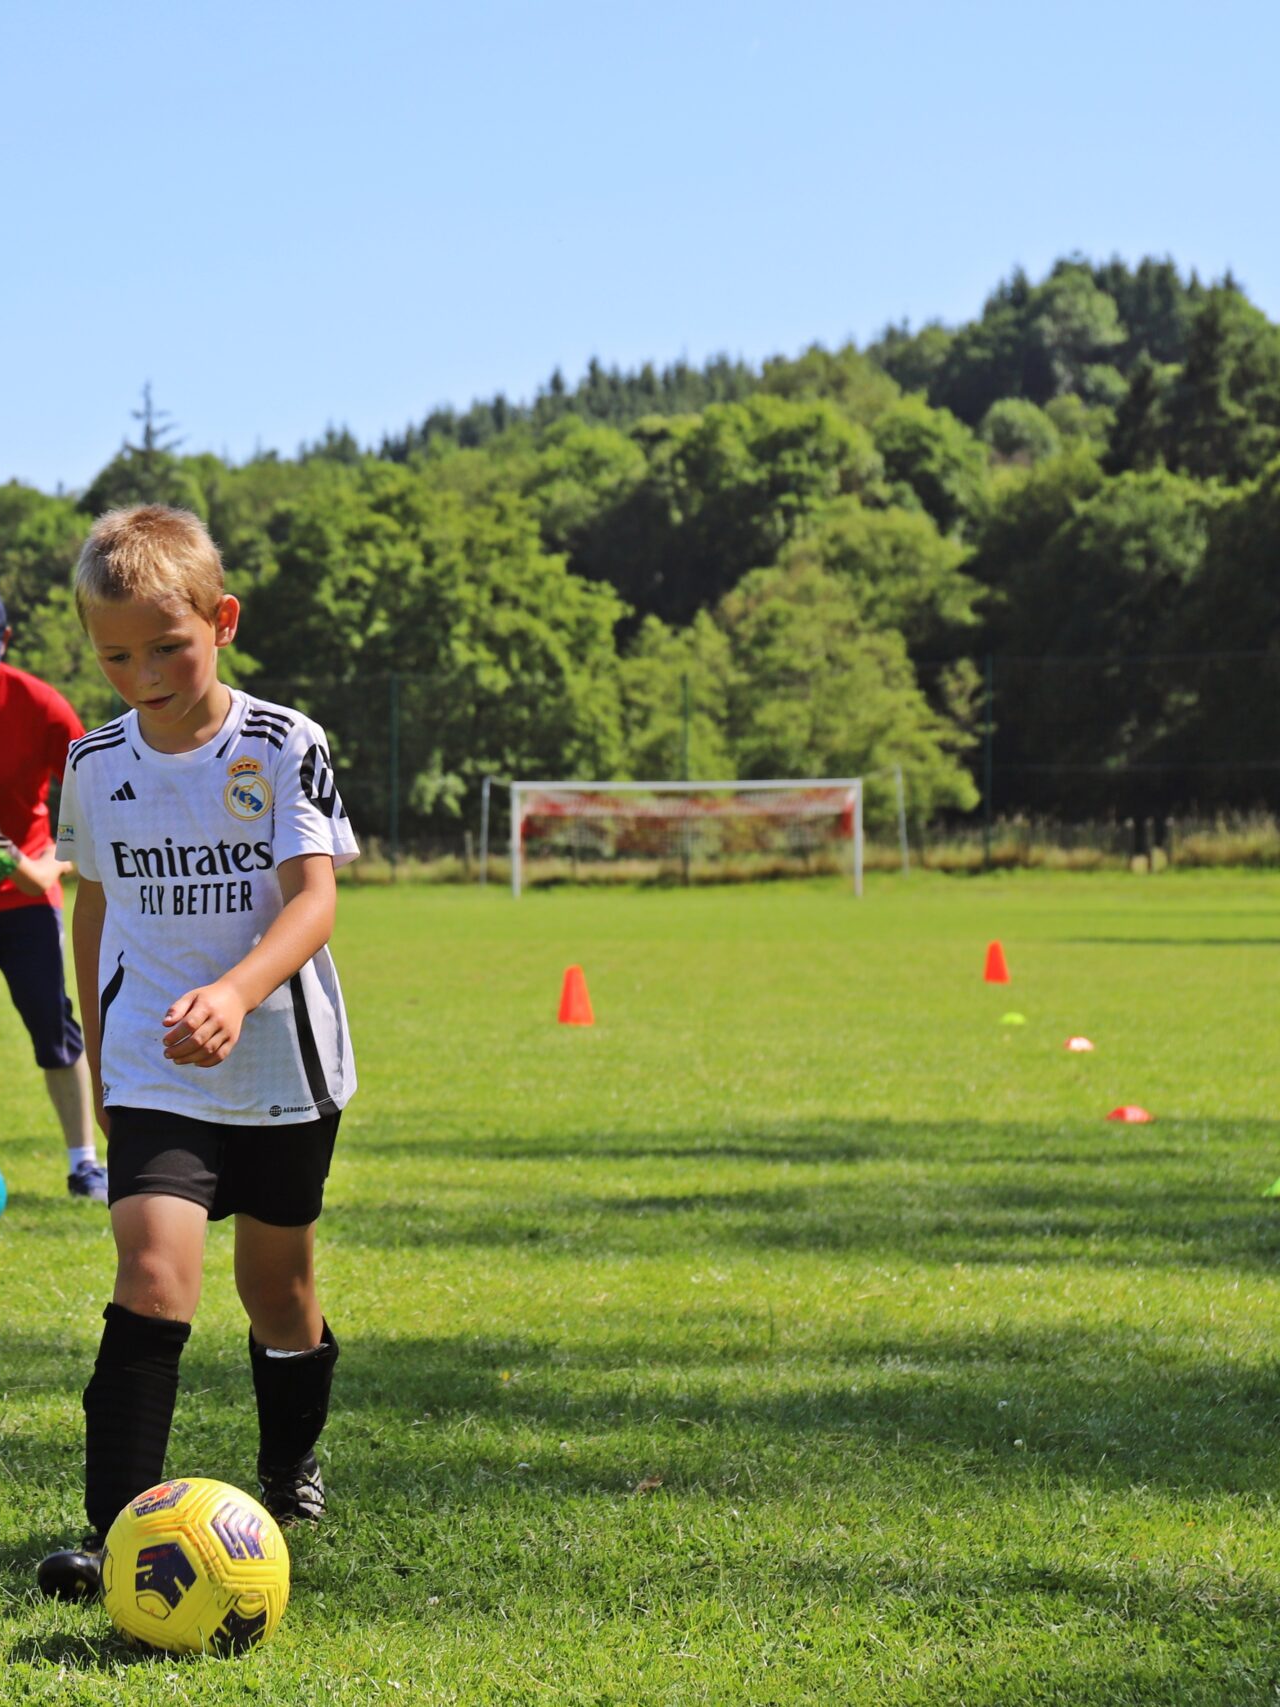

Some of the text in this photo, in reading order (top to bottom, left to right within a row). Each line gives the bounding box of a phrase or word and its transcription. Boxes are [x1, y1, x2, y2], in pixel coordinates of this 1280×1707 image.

[110, 837, 273, 878] Emirates
[140, 880, 253, 915] FLY BETTER
